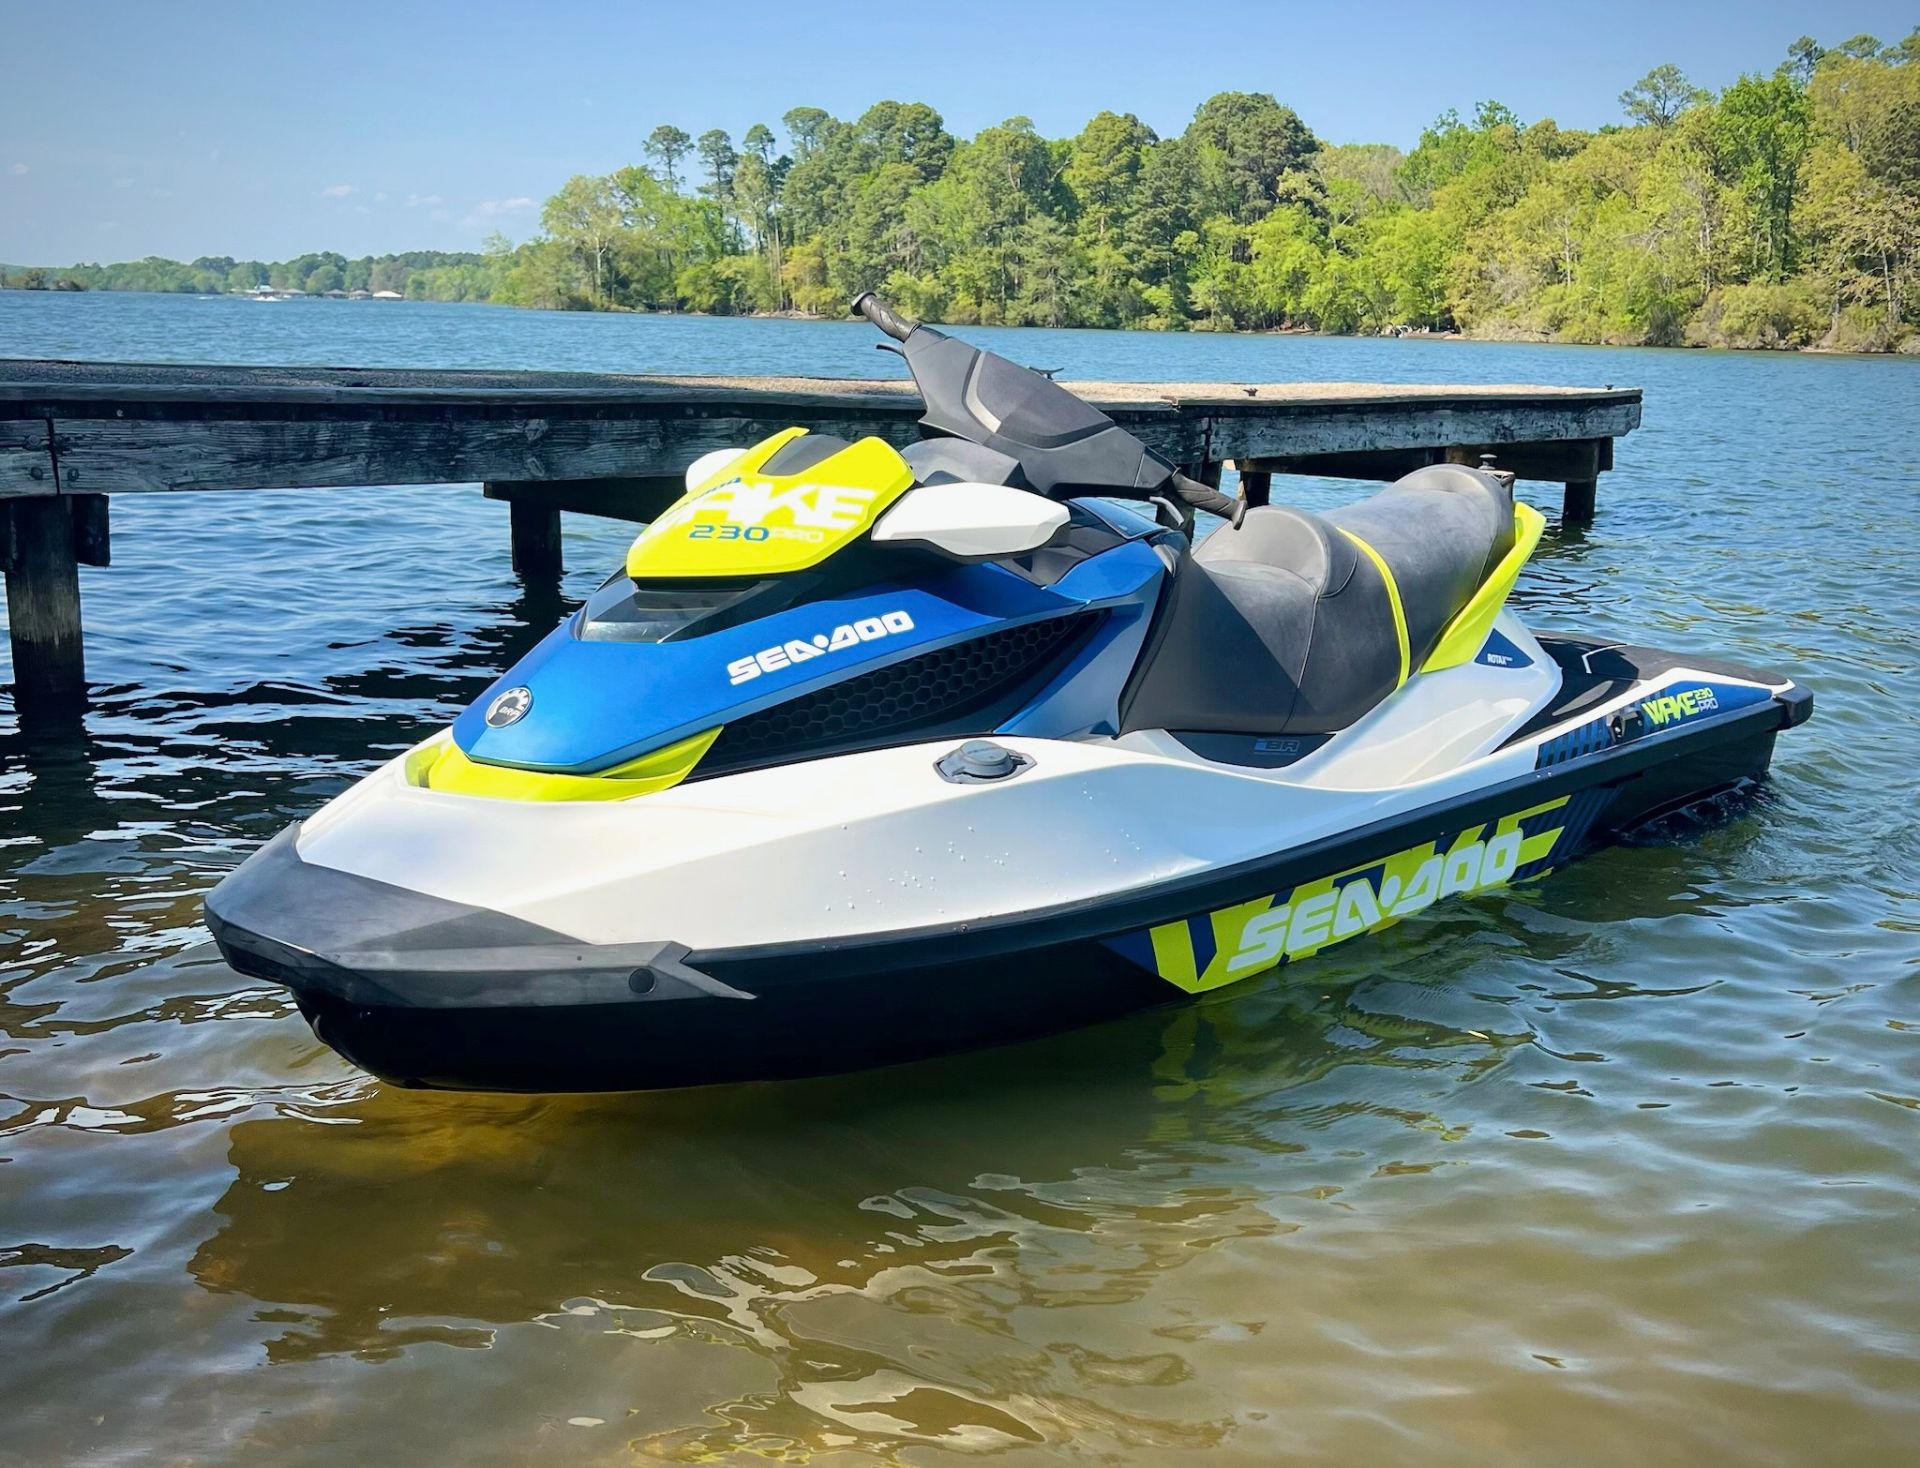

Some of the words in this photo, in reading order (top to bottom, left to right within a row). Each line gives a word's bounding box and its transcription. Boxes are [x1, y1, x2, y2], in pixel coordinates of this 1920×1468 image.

[650, 482, 877, 532] AKE
[689, 523, 769, 542] 230
[771, 527, 826, 544] PRO
[1487, 653, 1507, 666] ROTAX
[1641, 691, 1699, 725] WAKE
[1692, 687, 1713, 700] 230
[1697, 697, 1719, 712] PRO
